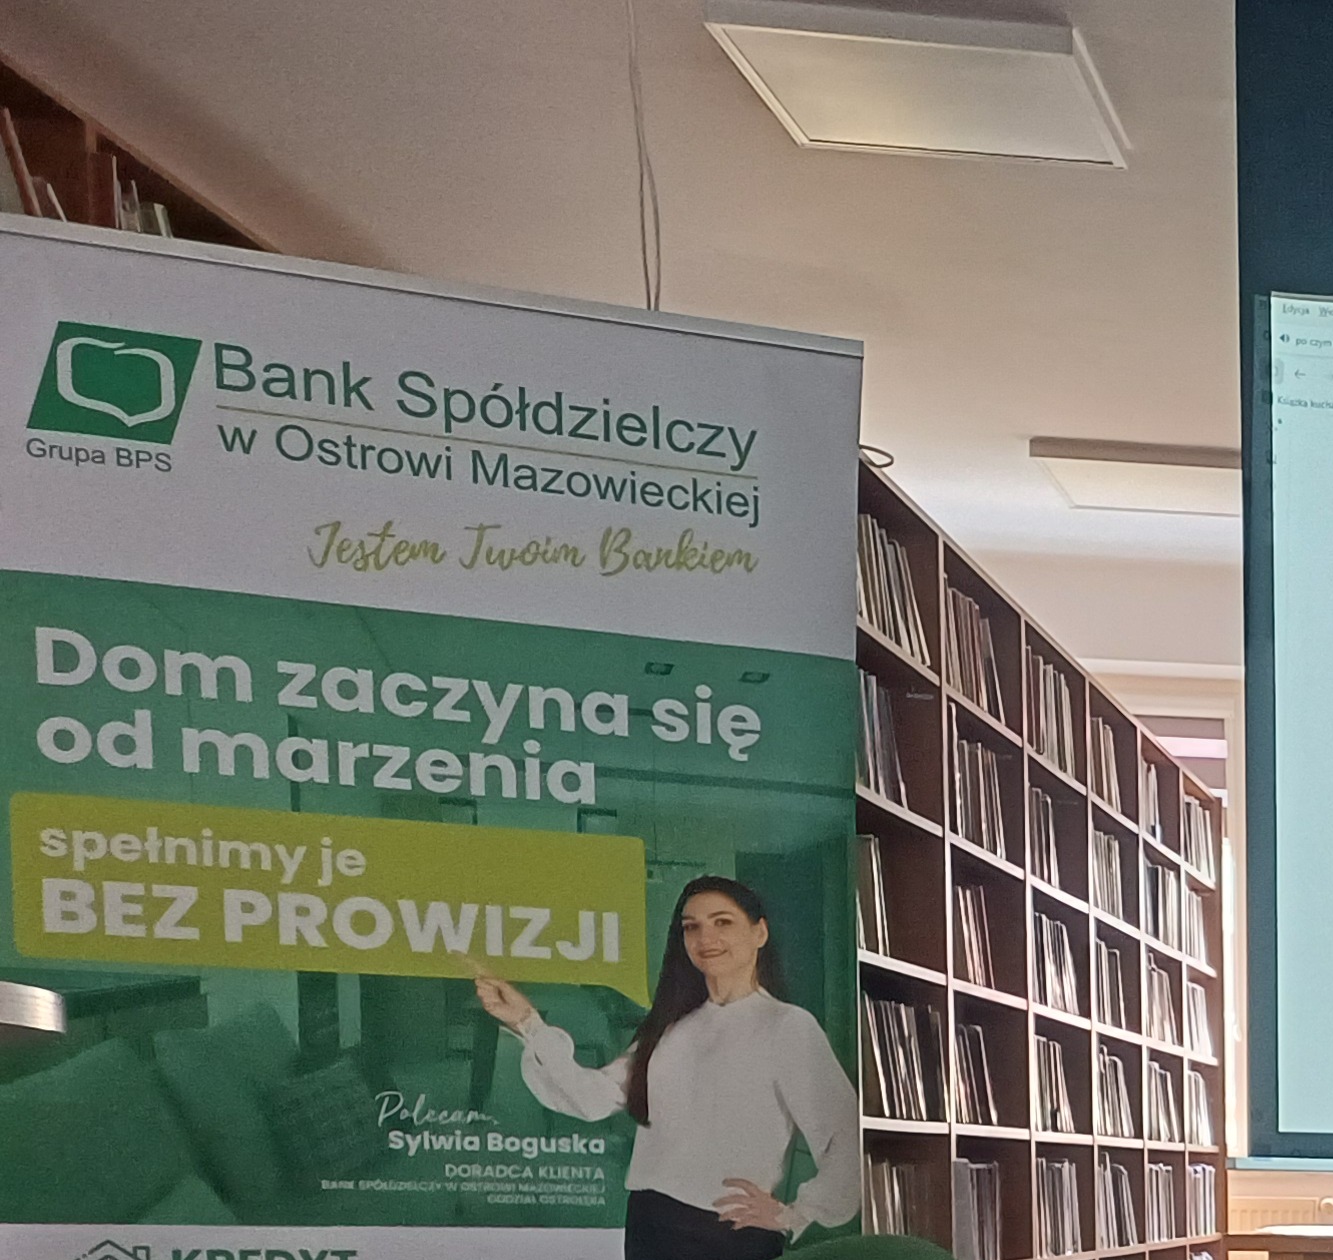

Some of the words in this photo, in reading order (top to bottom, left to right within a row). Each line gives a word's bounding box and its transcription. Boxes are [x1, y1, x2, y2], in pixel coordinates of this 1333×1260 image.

[1310, 339, 1332, 349] czym
[214, 342, 375, 411] Bank
[397, 370, 757, 470] Spółdzielczy
[25, 436, 106, 467] Grupa
[115, 445, 173, 473] BPS
[217, 423, 257, 455] w
[275, 424, 452, 480] Ostrowi
[471, 450, 760, 527] Mazowieckiej
[308, 520, 447, 573] Jestem
[459, 523, 586, 571] Twoim
[600, 525, 758, 577] Bankiem
[35, 626, 253, 704] Dom
[277, 659, 630, 745] zaczyna
[650, 684, 762, 763] się
[36, 710, 154, 770] od
[182, 725, 597, 806] marzenia
[40, 826, 305, 883] spełnimy
[317, 837, 367, 888] je
[41, 878, 200, 942] BEZ
[223, 890, 621, 963] PROWIZJI
[388, 1129, 480, 1157] Sylwia
[487, 1131, 605, 1159] Boguska
[445, 1163, 533, 1179] DORADCA
[538, 1165, 605, 1181] KLIENTA
